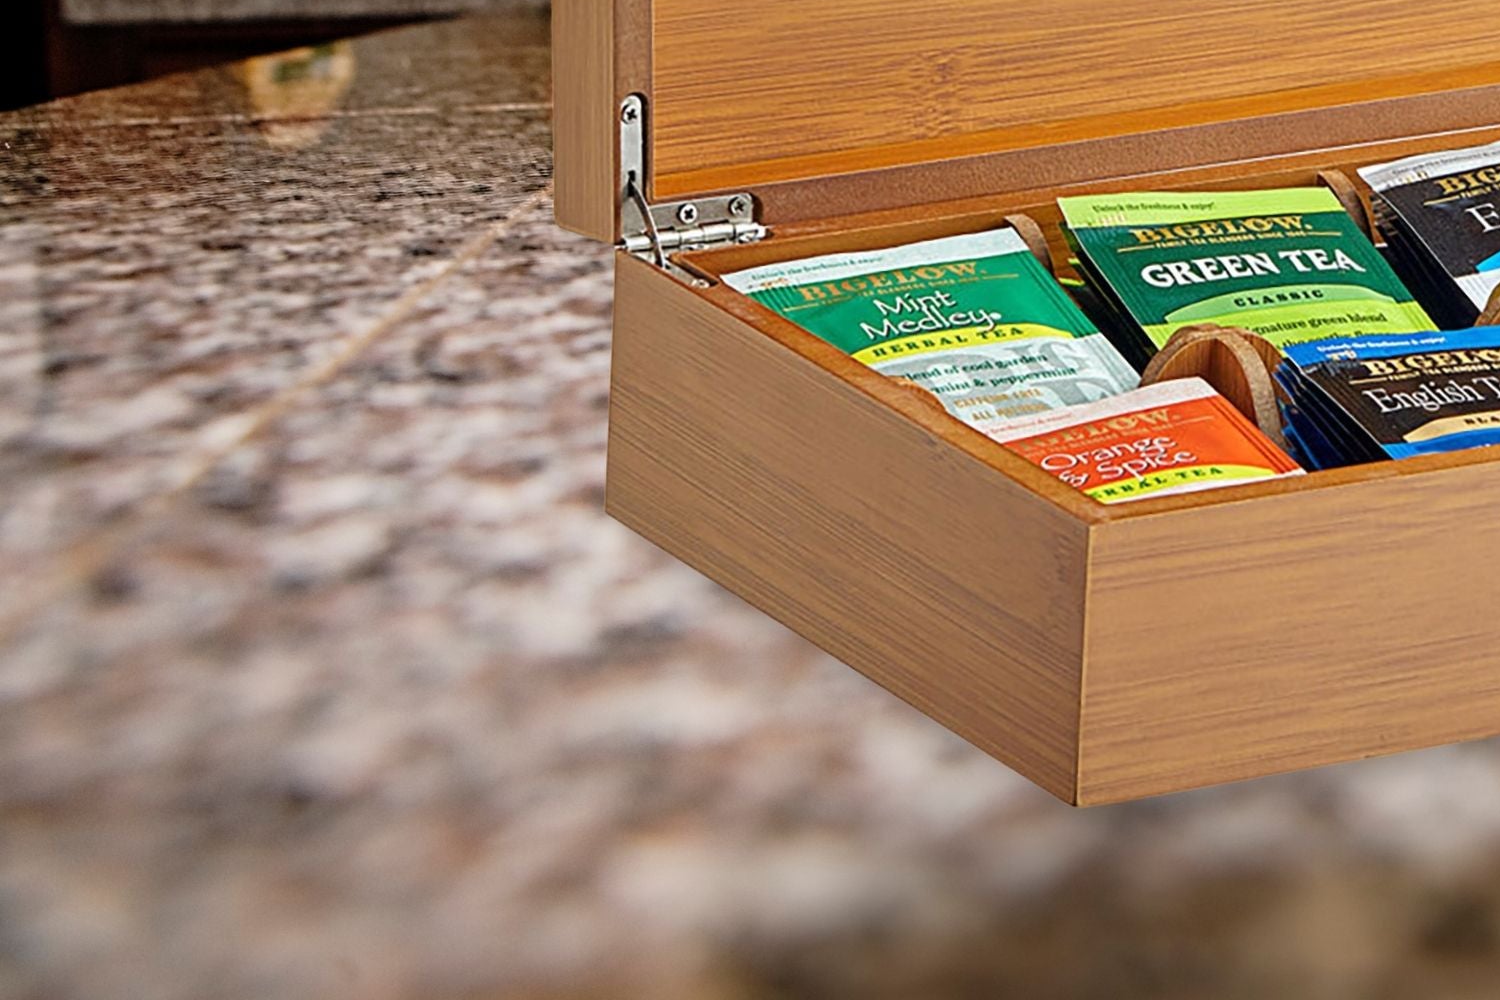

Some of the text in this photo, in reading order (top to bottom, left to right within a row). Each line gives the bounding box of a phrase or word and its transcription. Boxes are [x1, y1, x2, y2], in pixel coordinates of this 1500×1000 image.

[1140, 248, 1366, 288] GREEN TEA
[873, 290, 957, 316] Mint
[1234, 289, 1324, 307] CLASSIC
[1308, 316, 1349, 328] green
[1346, 312, 1388, 323] blend
[872, 326, 1025, 358] HERBAL TEA
[903, 353, 1049, 382] lend of cool garden
[973, 378, 986, 388] &
[990, 366, 1078, 388] peppermint
[1362, 380, 1485, 414] English
[1016, 408, 1171, 452] IGELOW
[1040, 436, 1177, 471] Orange
[1059, 450, 1198, 488] & Spice
[1090, 466, 1224, 500] ERBAL TEA
